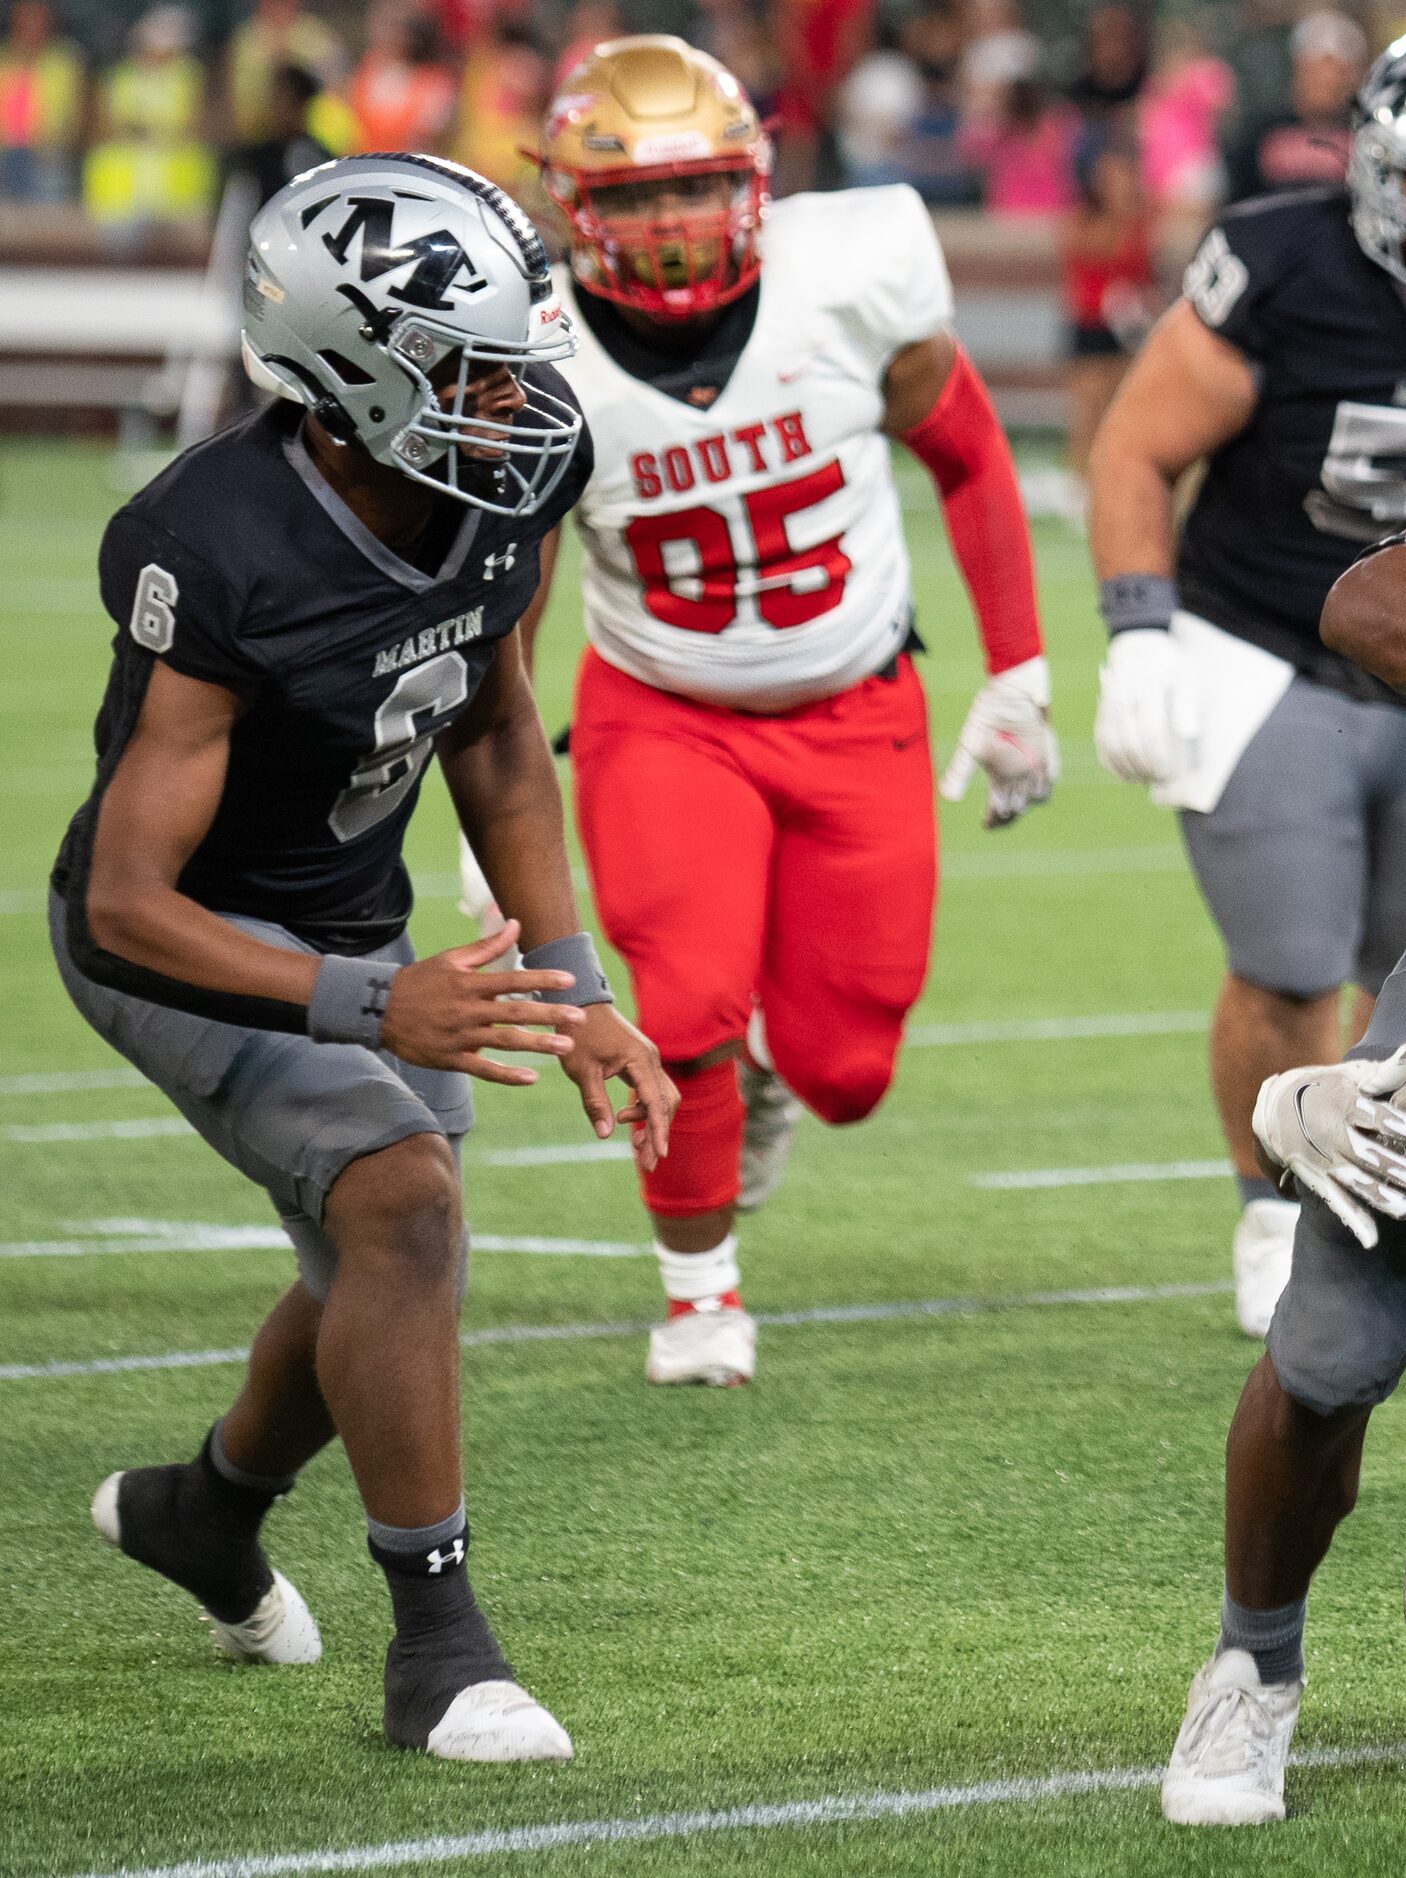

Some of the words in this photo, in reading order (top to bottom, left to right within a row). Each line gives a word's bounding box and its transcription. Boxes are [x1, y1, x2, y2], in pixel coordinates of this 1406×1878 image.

[631, 409, 813, 500] SOUTH
[129, 563, 179, 654] 6
[372, 605, 485, 678] MARTIN
